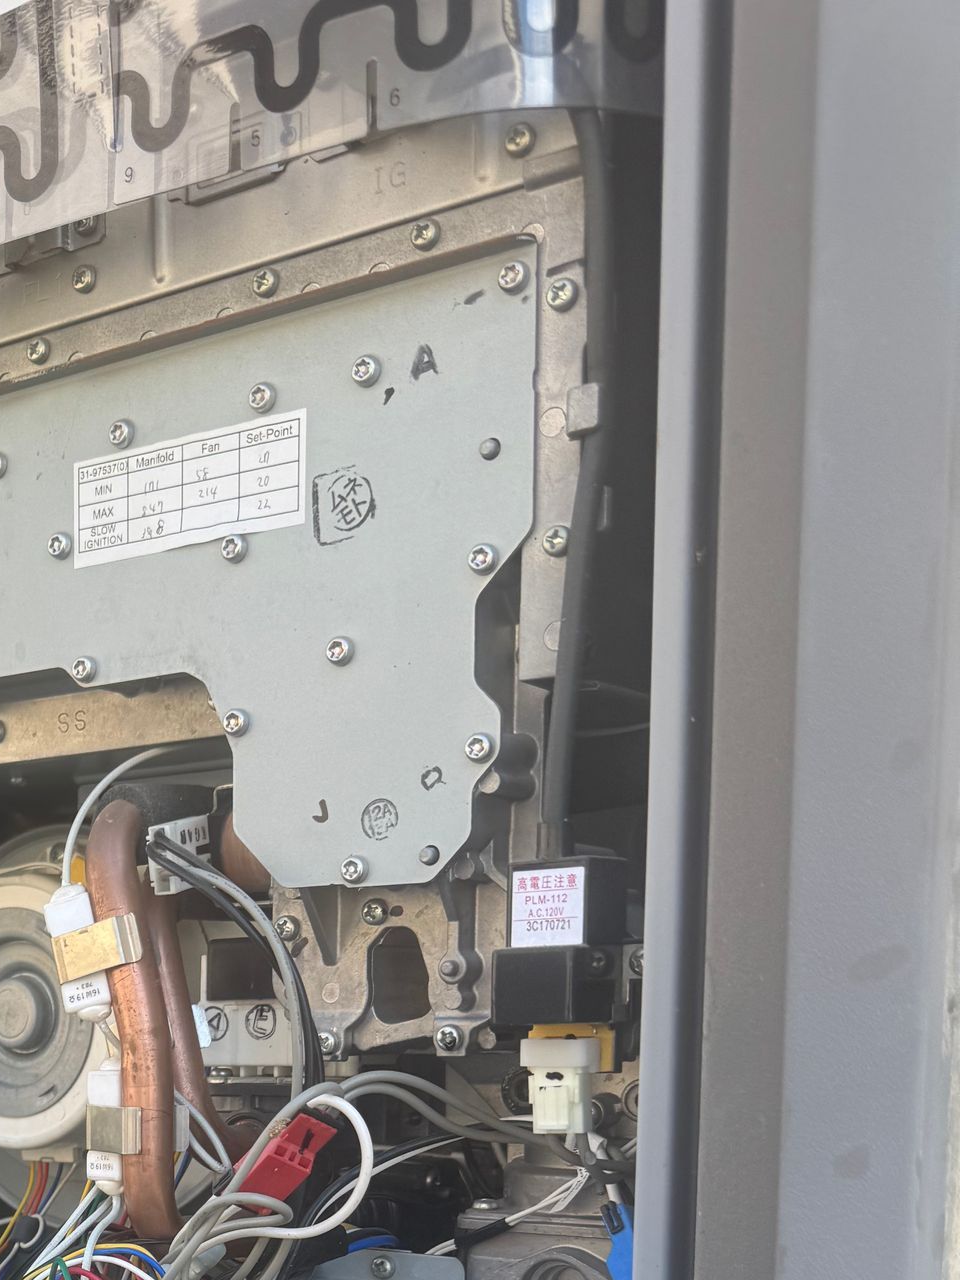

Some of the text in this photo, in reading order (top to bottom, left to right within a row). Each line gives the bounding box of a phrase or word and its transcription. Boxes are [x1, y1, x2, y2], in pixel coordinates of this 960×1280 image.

[124, 166, 134, 183] 9
[373, 161, 407, 195] IG
[136, 451, 175, 468] Manifold
[201, 443, 220, 454] Fan
[246, 425, 293, 443] Set-Point
[94, 483, 112, 497] MIN
[92, 506, 114, 520] MAX
[90, 524, 116, 537] SLOW
[84, 534, 123, 550] IGNITION
[57, 709, 87, 734] SS
[524, 893, 568, 905] PLM-112
[526, 919, 571, 932] 3C170721
